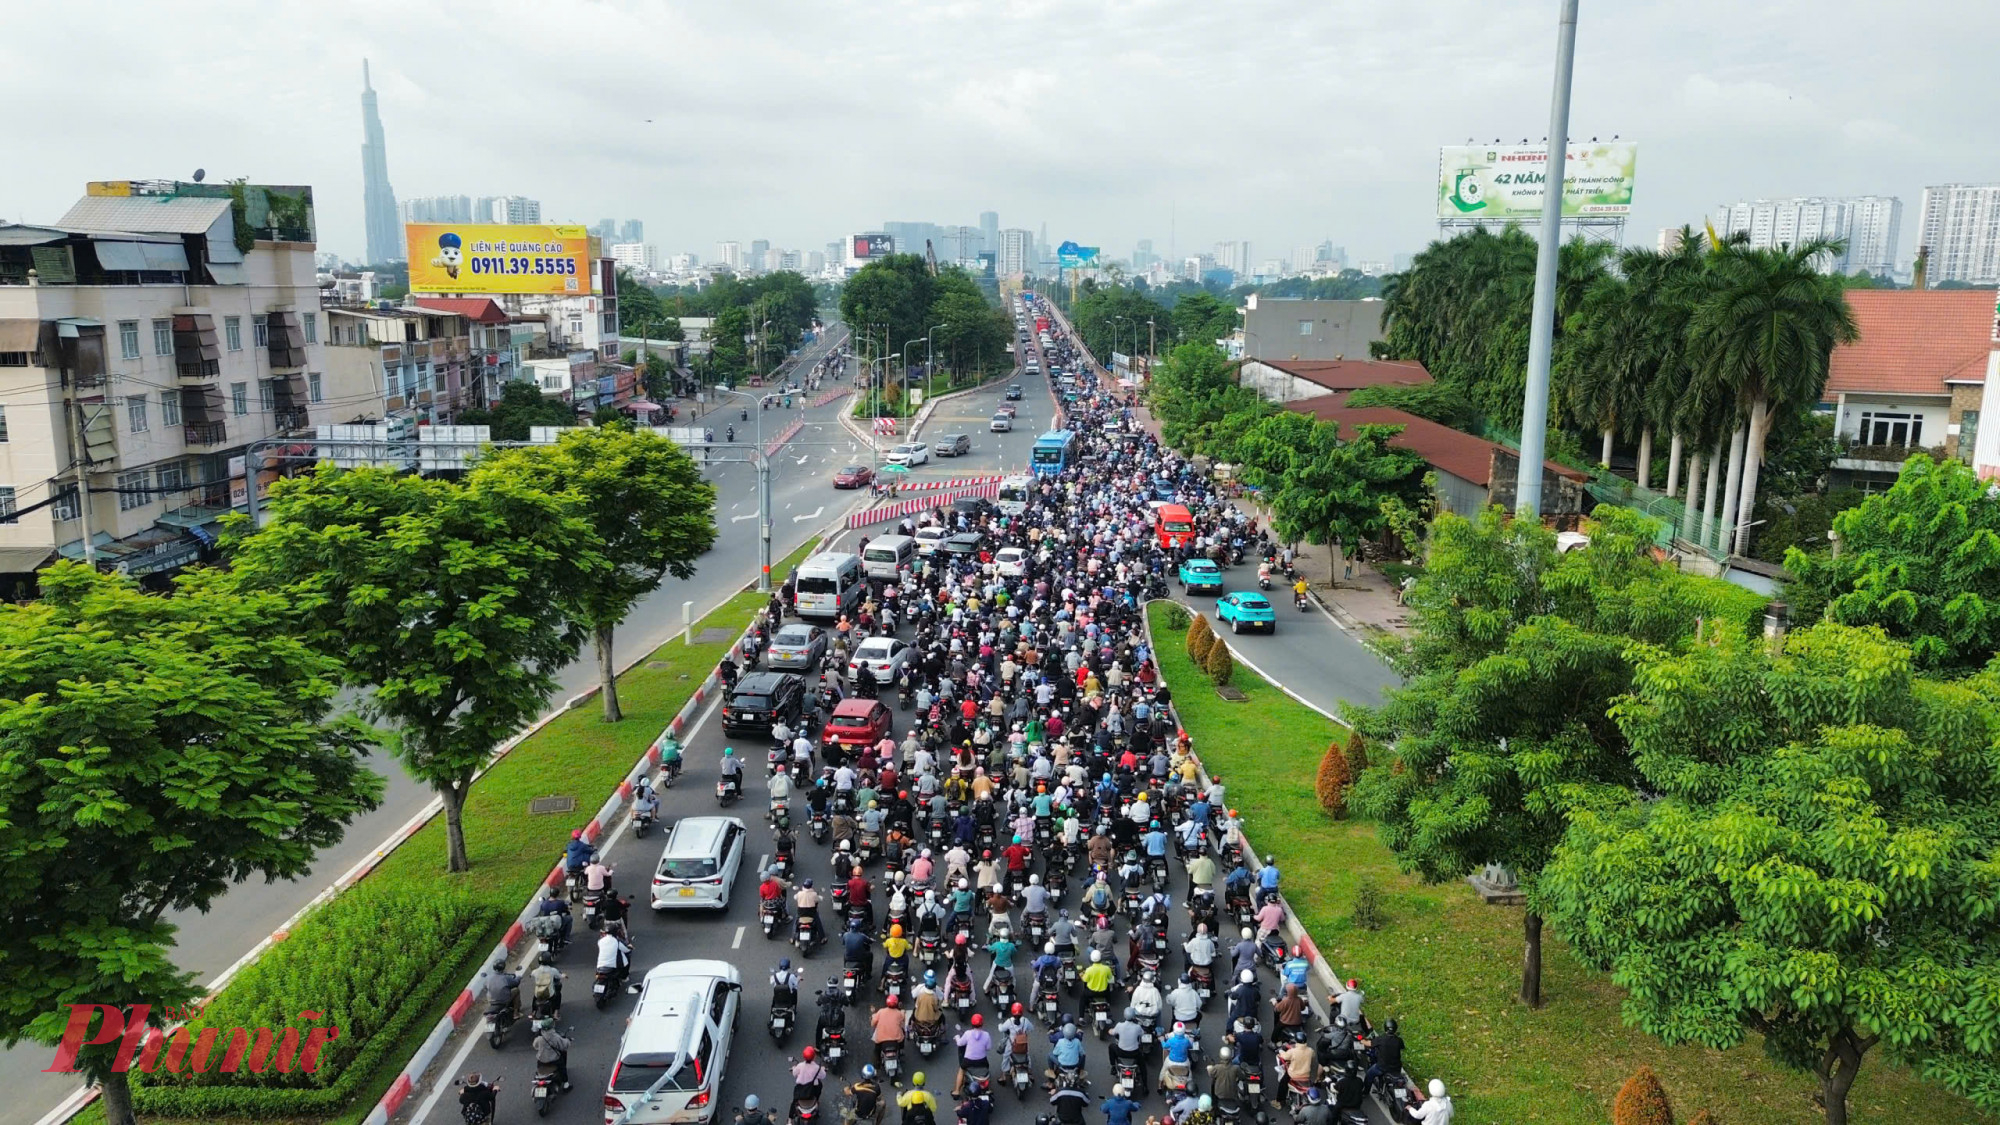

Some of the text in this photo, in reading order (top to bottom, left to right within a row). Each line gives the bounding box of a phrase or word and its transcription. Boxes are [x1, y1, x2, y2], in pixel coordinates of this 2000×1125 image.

[1494, 171, 1546, 184] 42 NĂM
[1512, 188, 1537, 196] KHÔNG
[1566, 187, 1584, 195] PHÁT
[471, 239, 562, 255] LIÊN HỆ QUẢNG CÁO
[471, 257, 576, 275] 0911.39.5555
